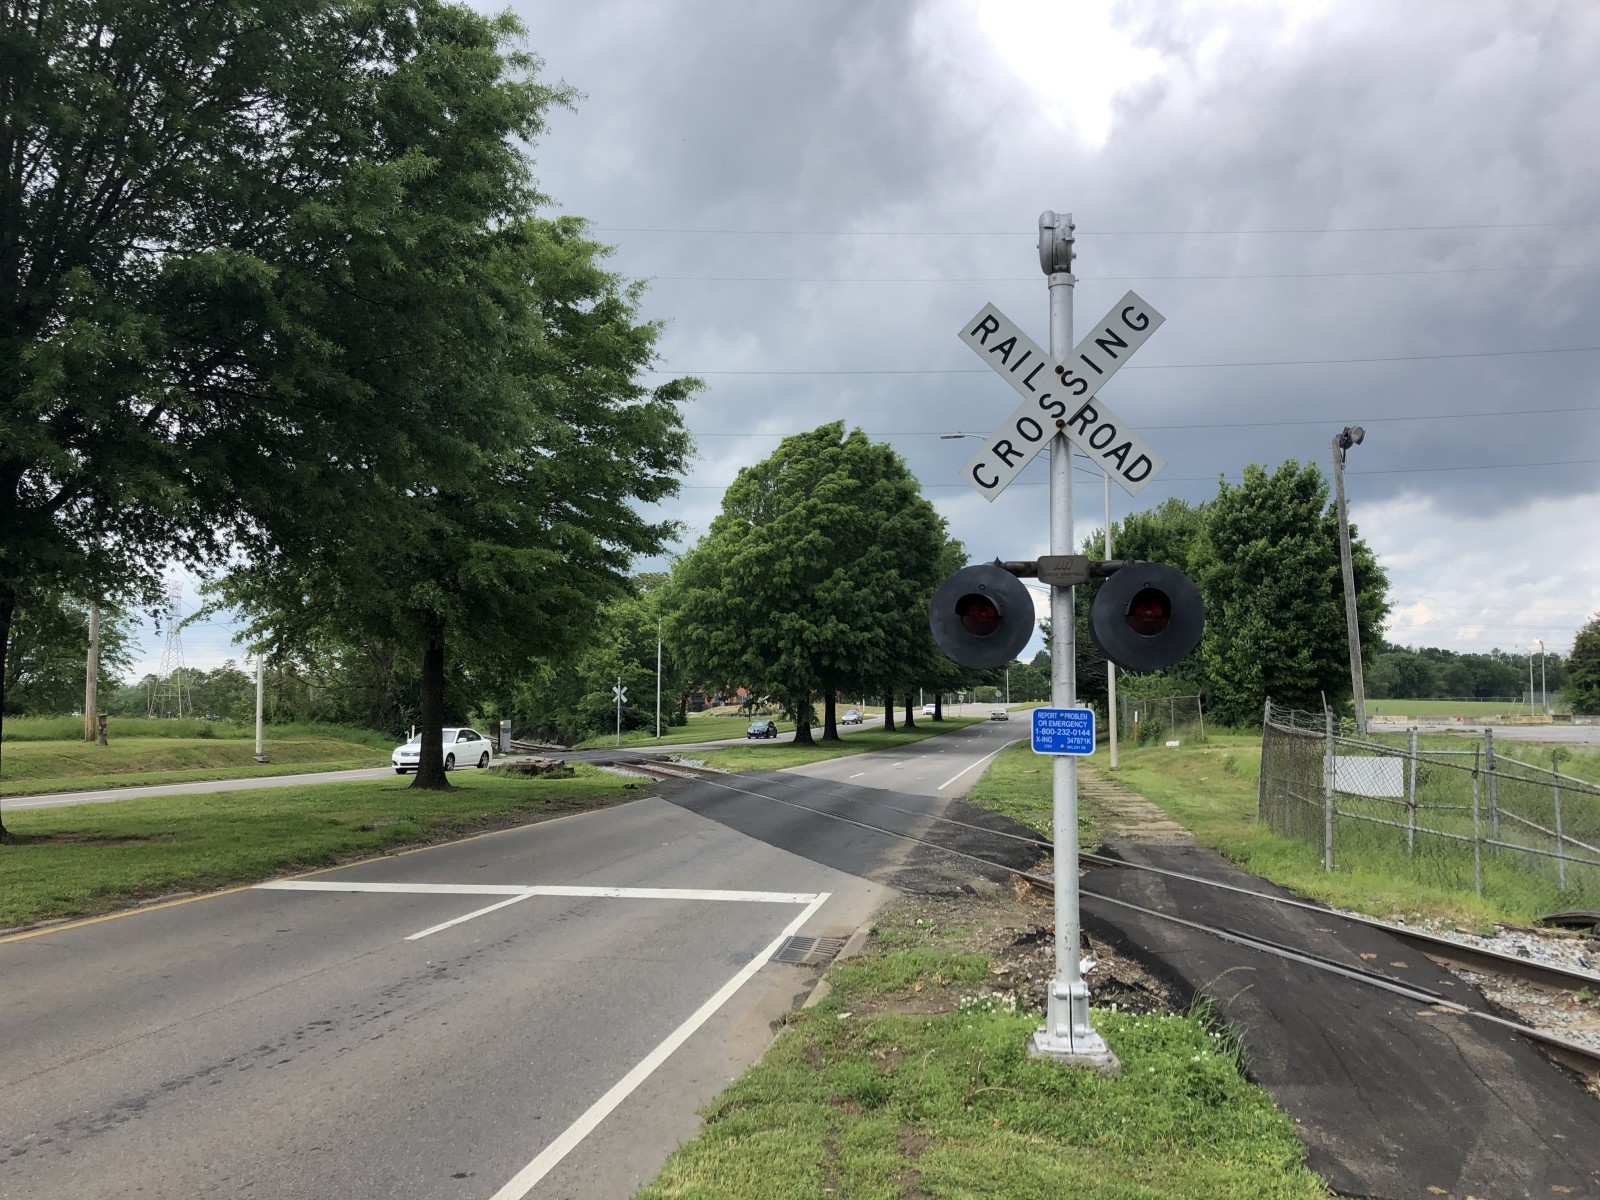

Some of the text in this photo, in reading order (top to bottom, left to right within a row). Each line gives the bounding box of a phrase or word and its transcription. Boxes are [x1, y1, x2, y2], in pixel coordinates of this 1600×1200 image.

[970, 313, 1153, 482] RAIL ROAD
[972, 306, 1150, 489] CROSSING
[1035, 728, 1091, 736] 1-800-232-0144
[1048, 720, 1088, 728] EMERGENCY
